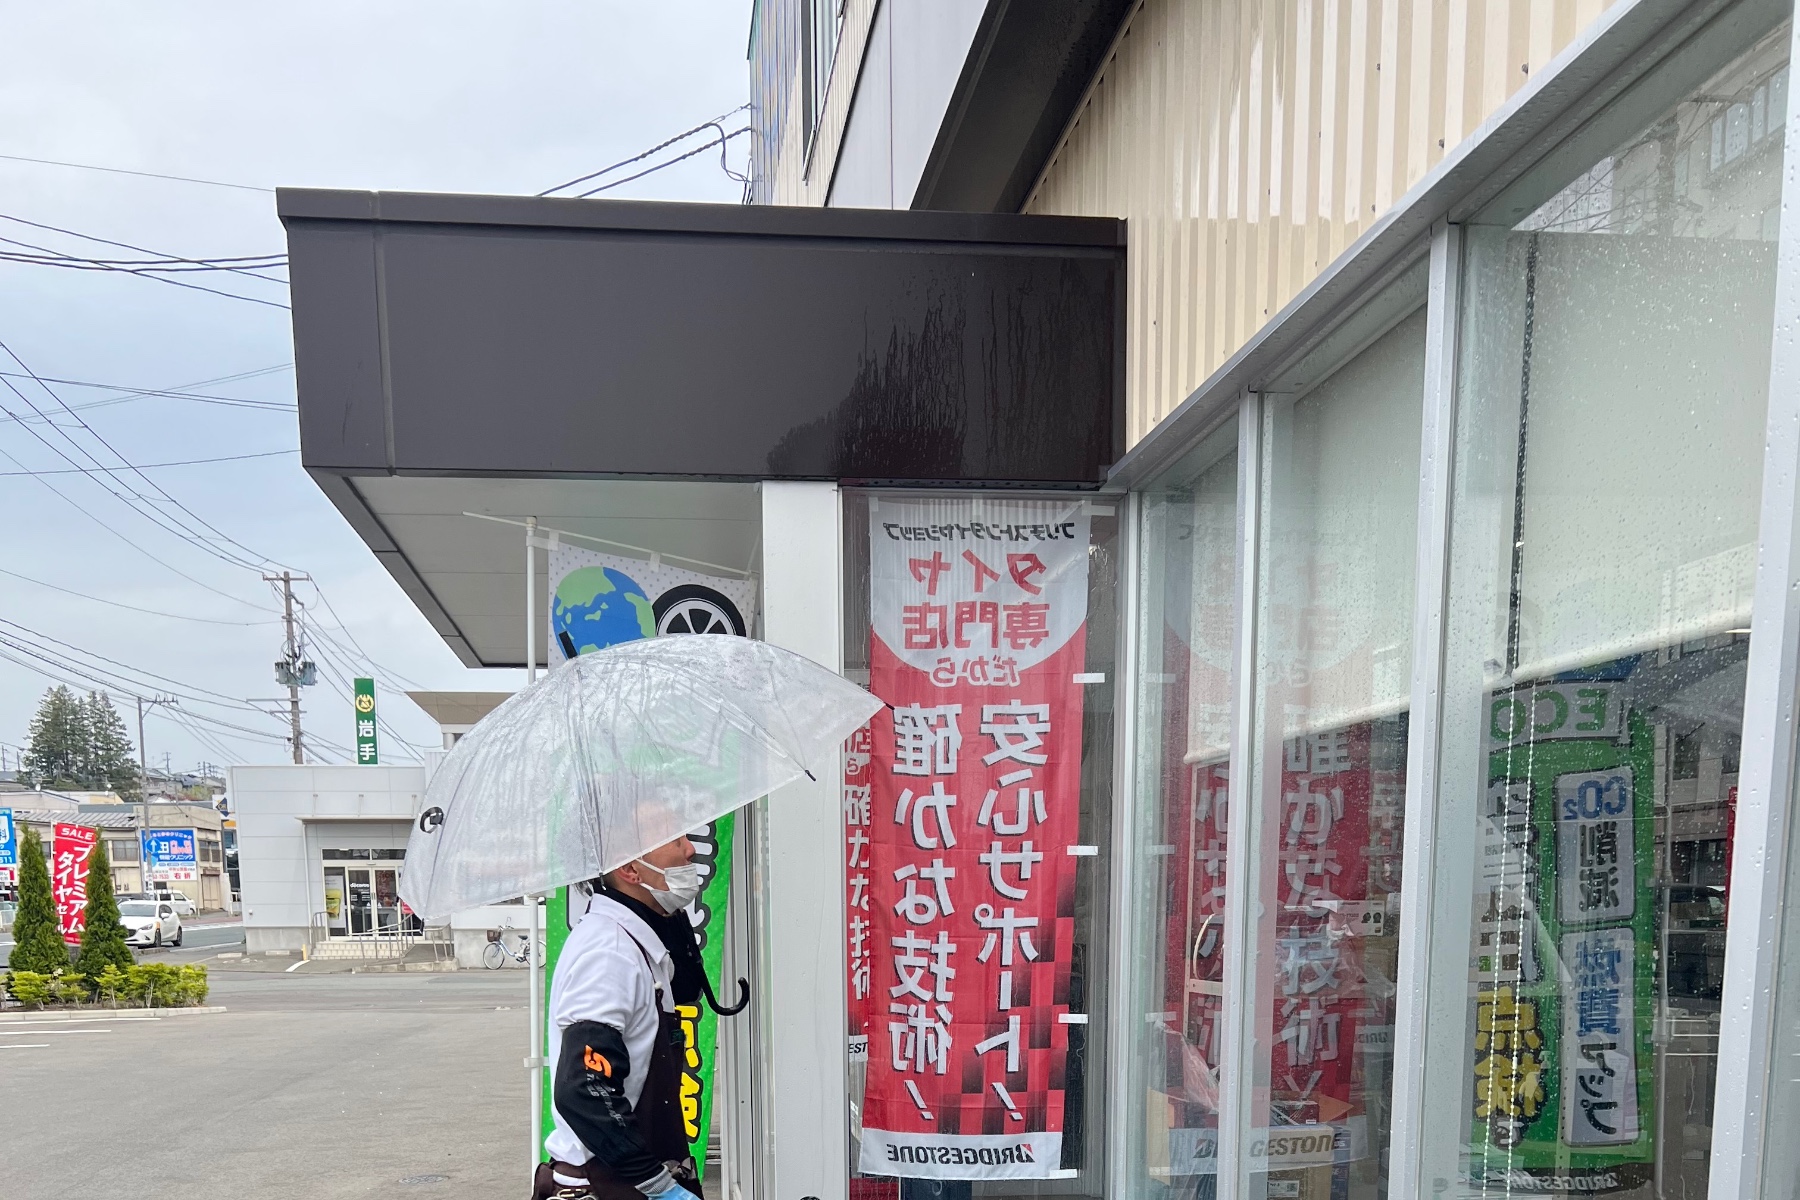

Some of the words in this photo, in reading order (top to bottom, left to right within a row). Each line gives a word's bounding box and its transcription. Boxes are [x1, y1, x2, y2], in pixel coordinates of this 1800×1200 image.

[61, 827, 94, 840] SALE
[68, 844, 94, 934] プレミアム
